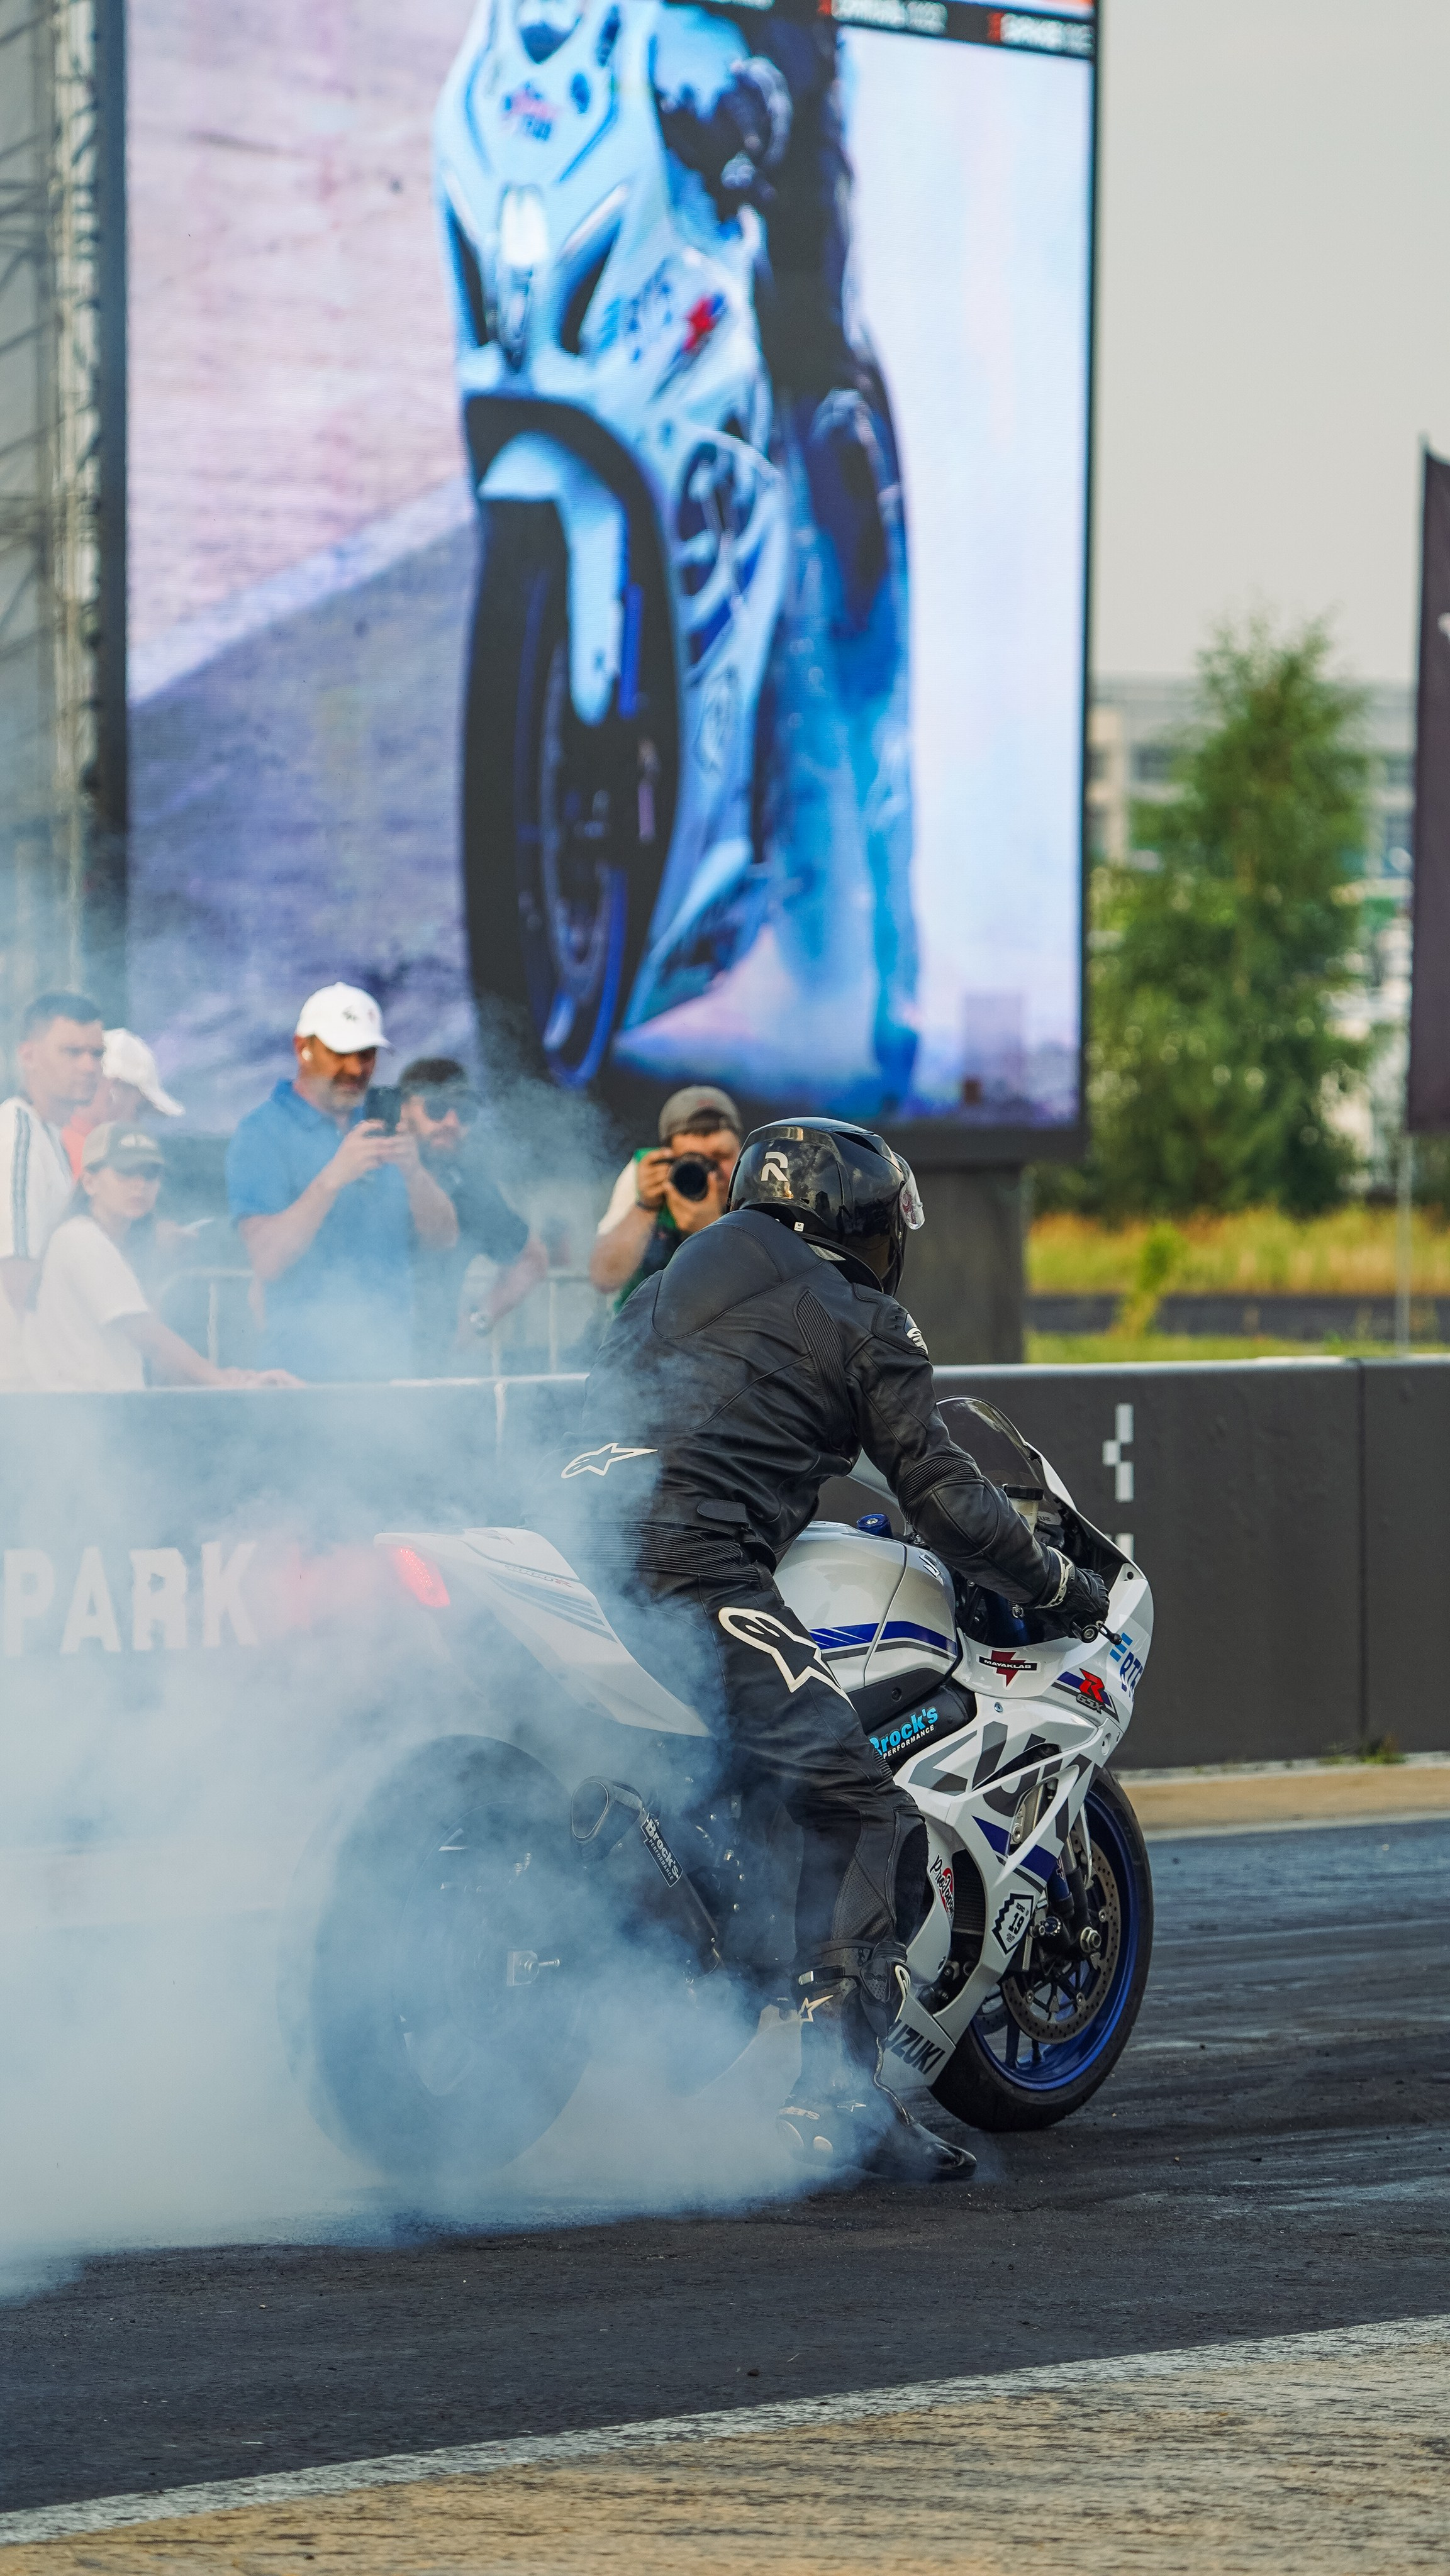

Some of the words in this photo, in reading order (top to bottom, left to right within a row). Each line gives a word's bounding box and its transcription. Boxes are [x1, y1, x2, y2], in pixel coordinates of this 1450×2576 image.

[3, 1541, 258, 1657] PARK
[983, 1659, 1032, 1669] MAYAKLAB
[1076, 1692, 1104, 1714] GSX
[883, 1724, 935, 1760] PERFORMANCE
[645, 1818, 679, 1877] Brock's
[649, 1839, 674, 1881] PERFORMANCE
[1008, 1913, 1025, 1935] 19
[885, 2018, 946, 2075] UZUKI
